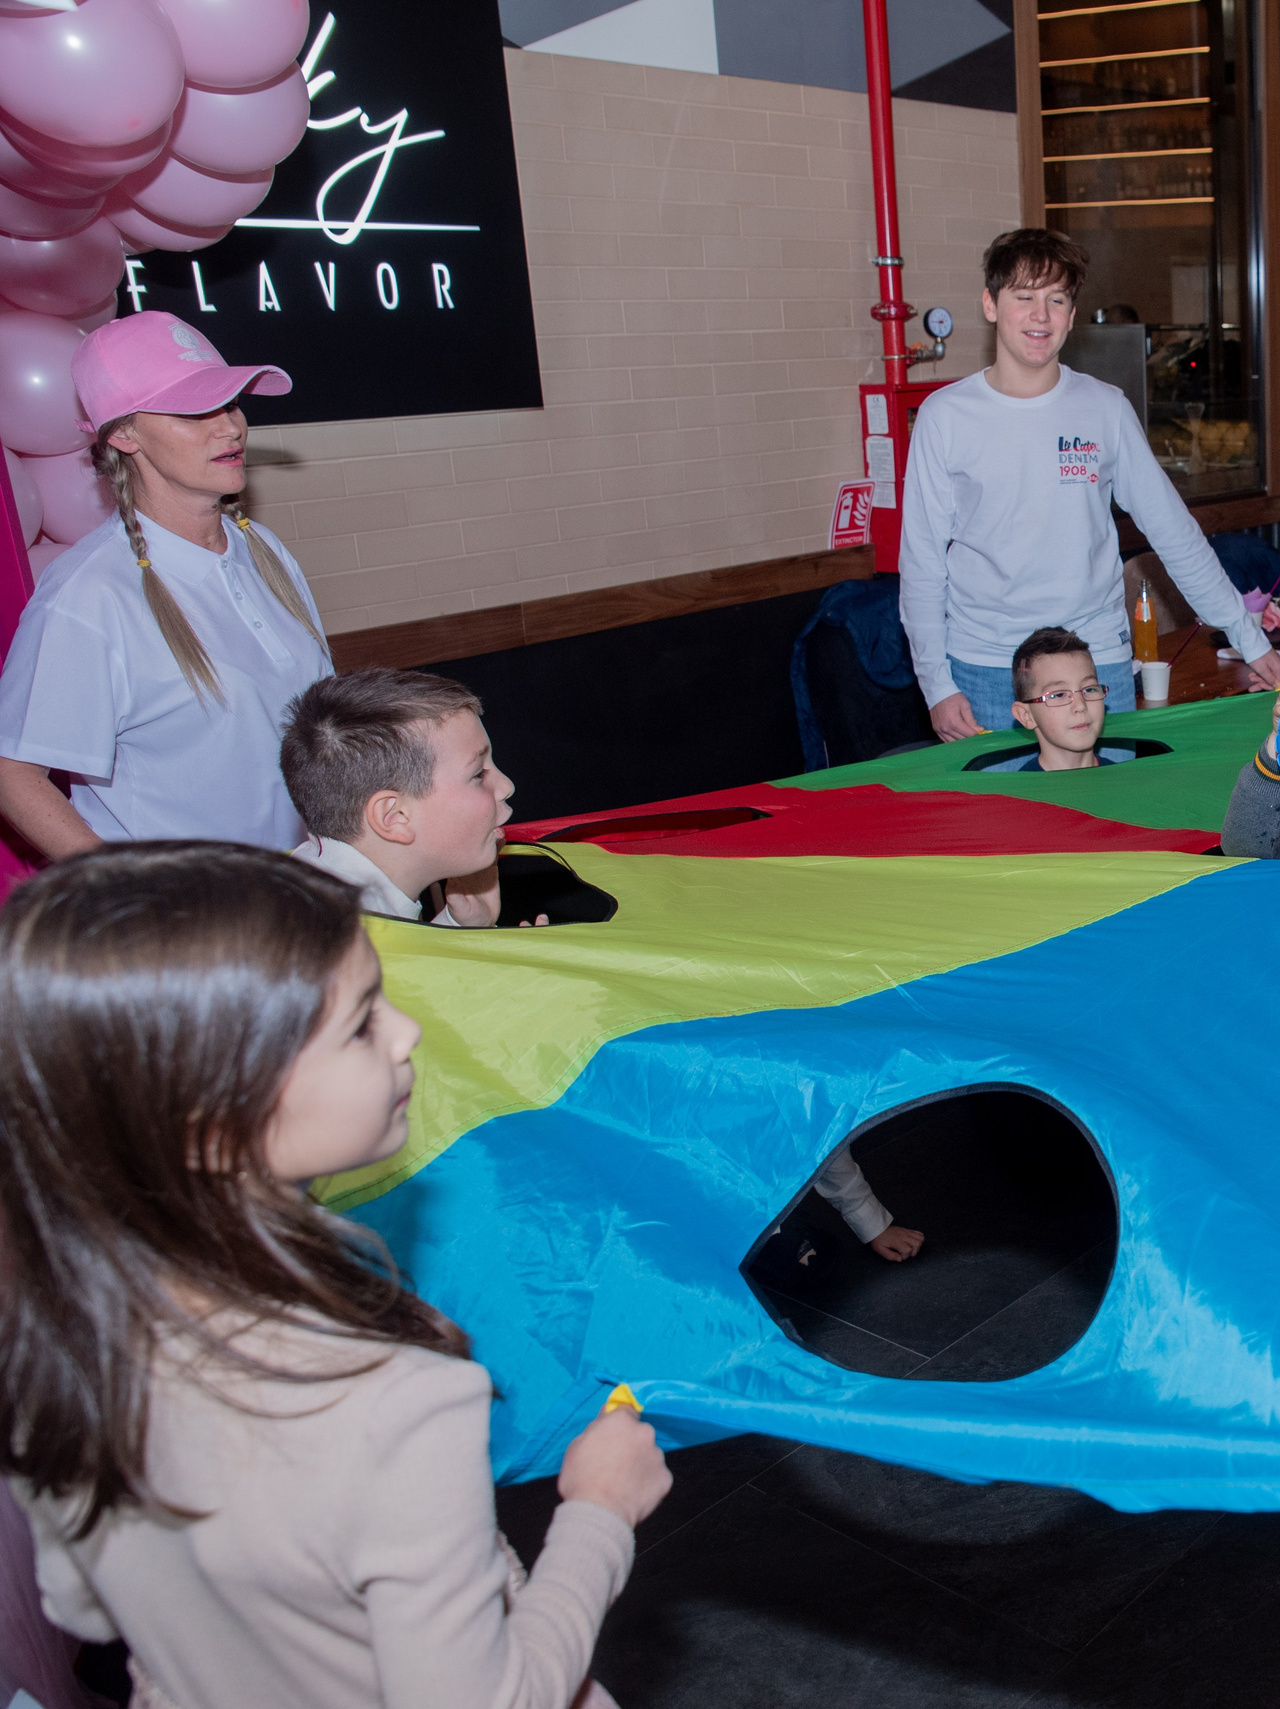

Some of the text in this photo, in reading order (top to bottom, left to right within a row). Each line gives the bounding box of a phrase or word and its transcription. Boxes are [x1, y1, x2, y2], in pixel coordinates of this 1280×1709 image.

[125, 259, 455, 312] FLAVOR
[1058, 436, 1100, 456] Lee Cooper
[1059, 453, 1098, 464] DENIM
[1059, 465, 1087, 477] 1908
